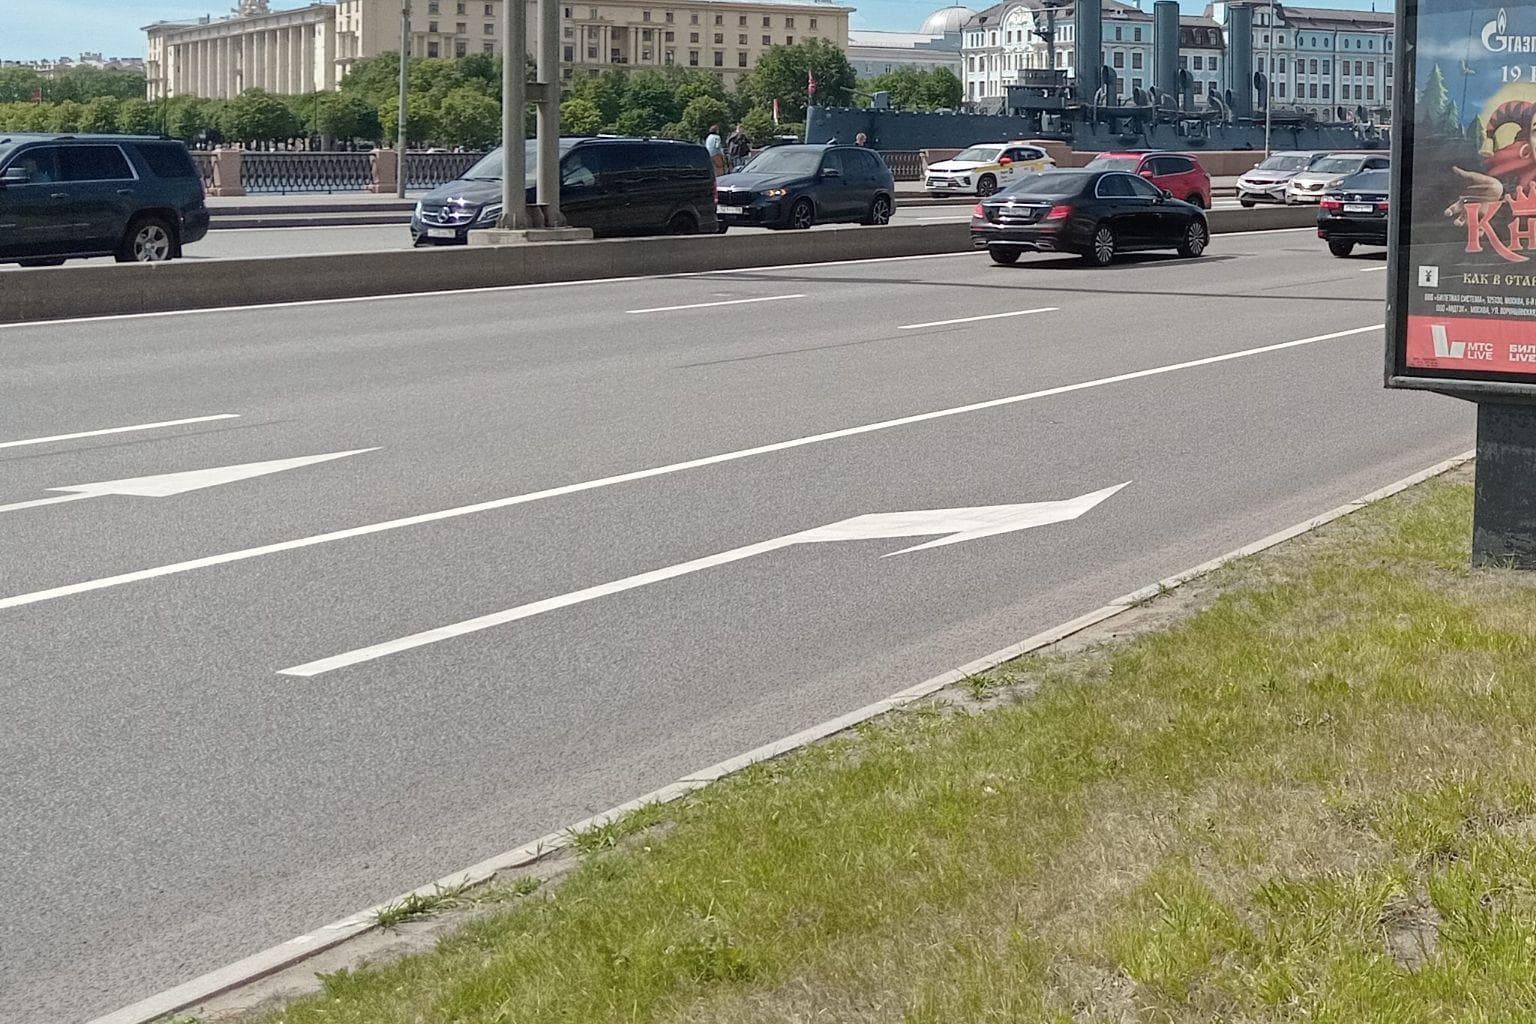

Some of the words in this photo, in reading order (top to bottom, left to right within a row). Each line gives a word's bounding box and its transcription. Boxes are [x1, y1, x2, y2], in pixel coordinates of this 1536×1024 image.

[1501, 65, 1522, 82] 19
[1462, 272, 1489, 285] КАК
[1493, 274, 1501, 285] В
[1467, 342, 1494, 352] МТС
[1467, 351, 1493, 360] LIVE
